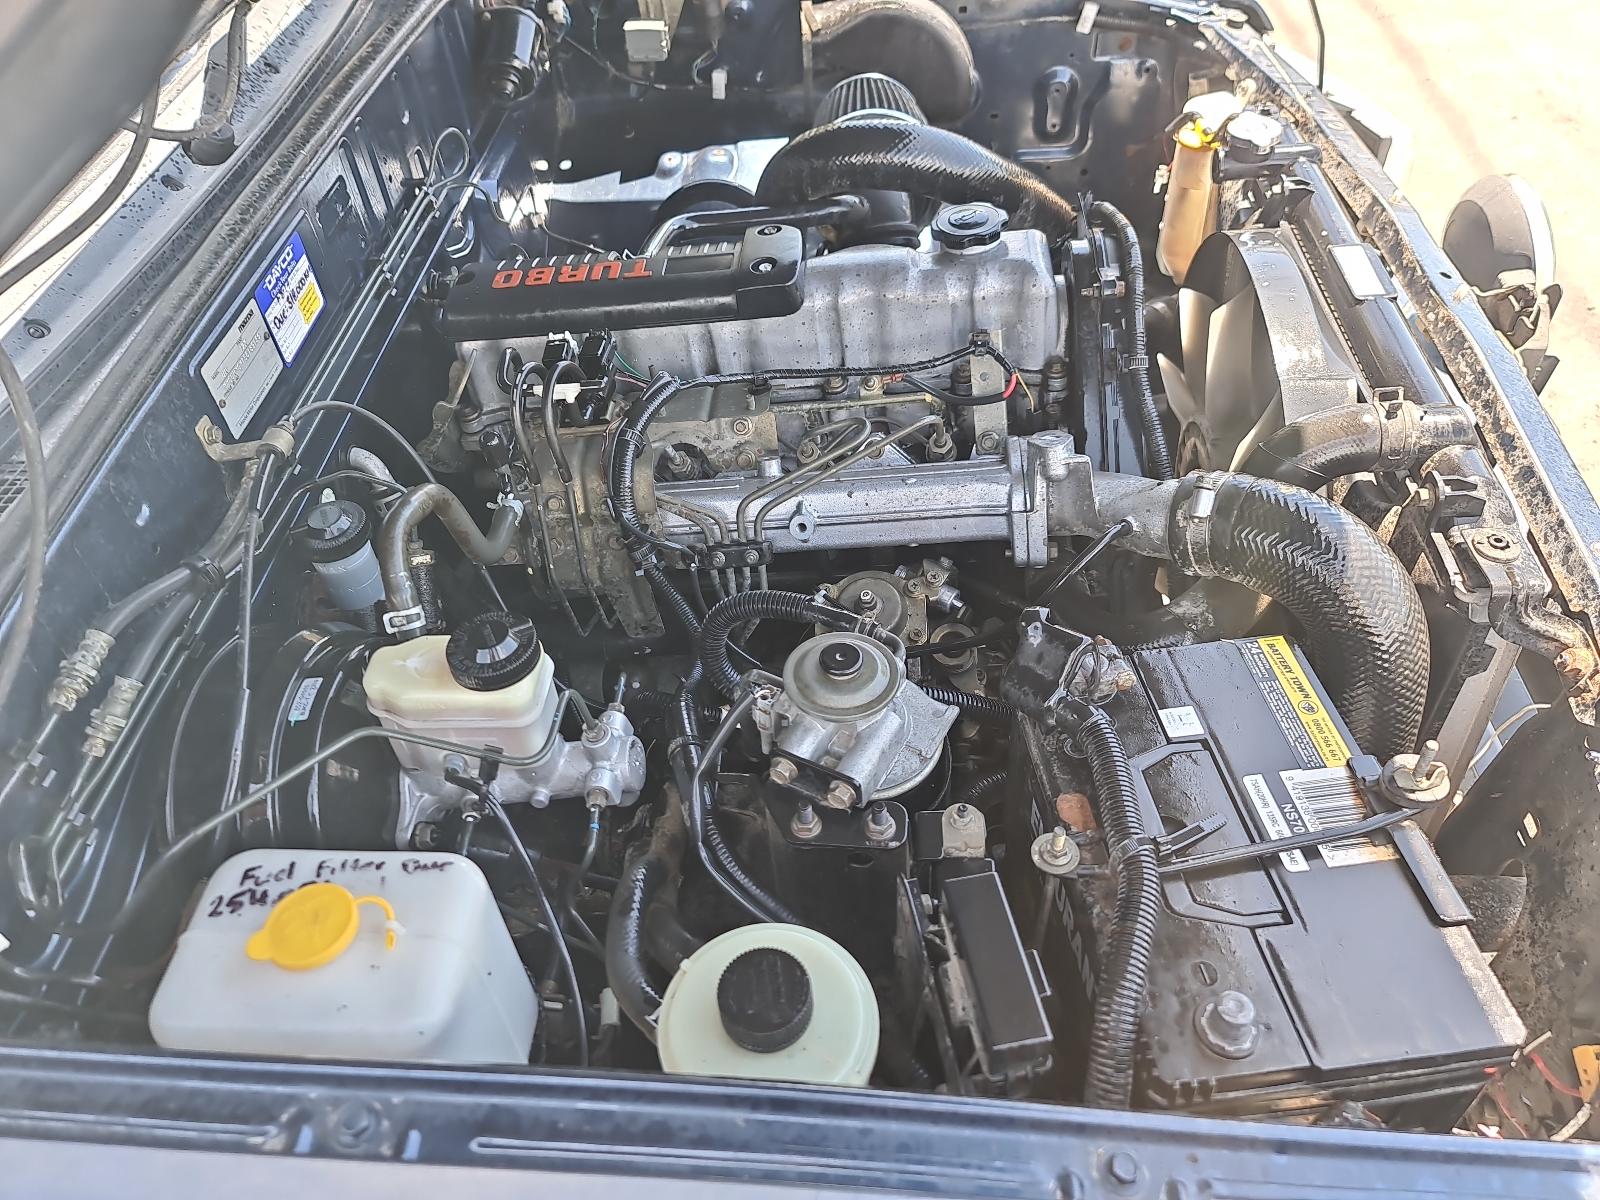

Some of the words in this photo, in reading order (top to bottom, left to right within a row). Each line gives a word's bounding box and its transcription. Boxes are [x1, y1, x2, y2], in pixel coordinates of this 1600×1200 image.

[263, 244, 294, 291] DAYCO
[491, 258, 653, 289] TURBO
[237, 308, 254, 333] mazda
[1246, 642, 1262, 654] 24
[1254, 654, 1269, 678] WARRANTY
[1267, 643, 1294, 674] BATTERY
[1289, 675, 1312, 699] TOWN
[1311, 718, 1325, 735] 0800
[1320, 735, 1331, 748] 566
[1329, 749, 1342, 762] 667
[1281, 803, 1305, 833] NS70
[240, 861, 296, 887] Fuel
[315, 858, 386, 879] Filter
